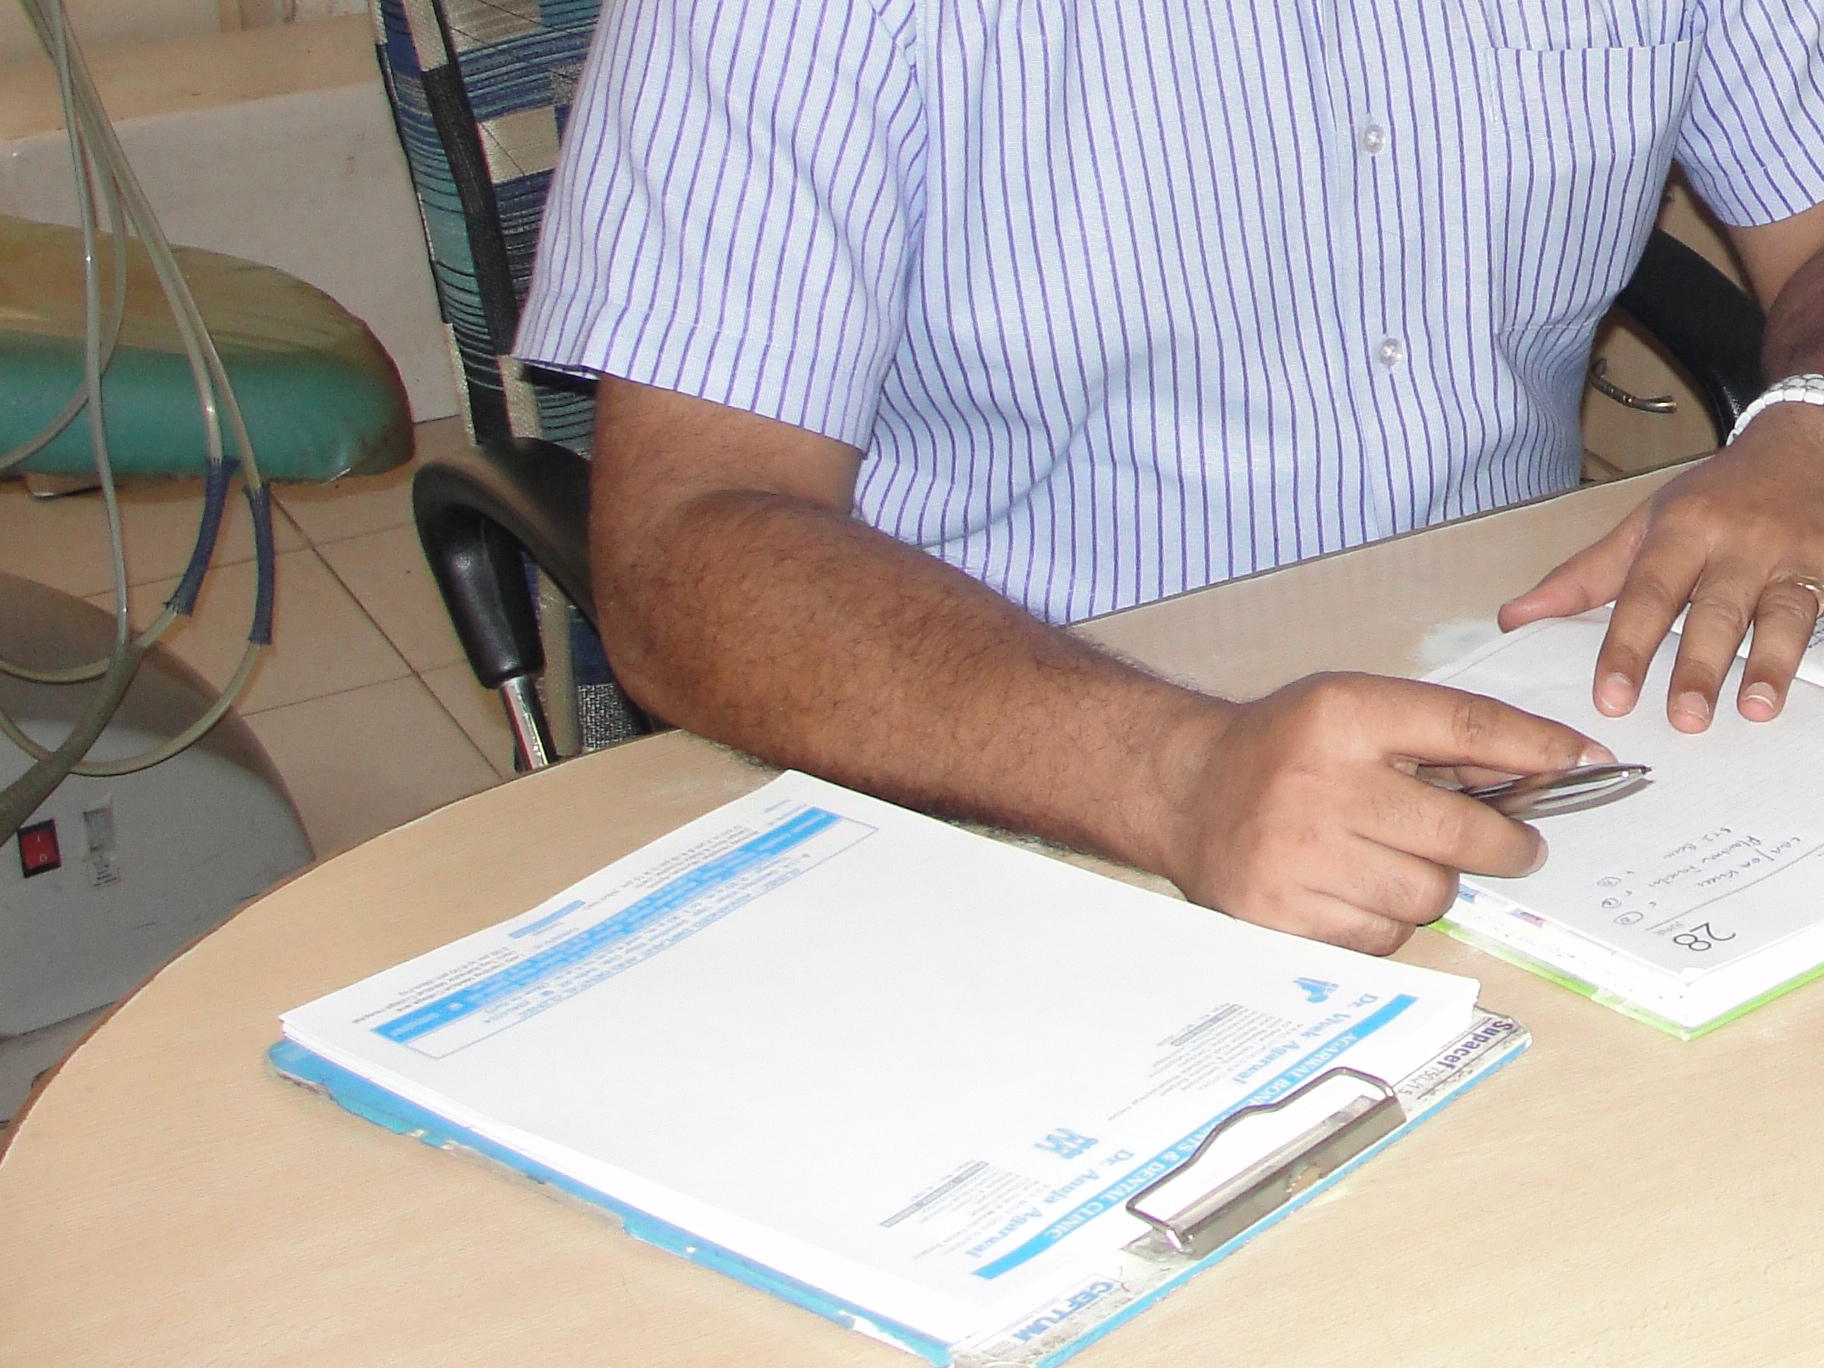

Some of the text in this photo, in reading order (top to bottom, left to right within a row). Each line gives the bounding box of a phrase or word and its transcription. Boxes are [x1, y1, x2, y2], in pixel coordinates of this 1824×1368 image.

[1672, 921, 1737, 952] 28
[1232, 993, 1380, 1085] Dr. Vivek Agarwal
[1290, 1033, 1358, 1079] AGARWAL
[1437, 1020, 1515, 1070] Supacef
[1099, 1148, 1135, 1166] Dr.
[1043, 1169, 1101, 1204] Anuja
[1106, 1161, 1166, 1202] DENTAL
[965, 1207, 1044, 1258] Agarwal
[1046, 1201, 1105, 1239] CLINIC
[1012, 1281, 1114, 1343] CEFTUM
